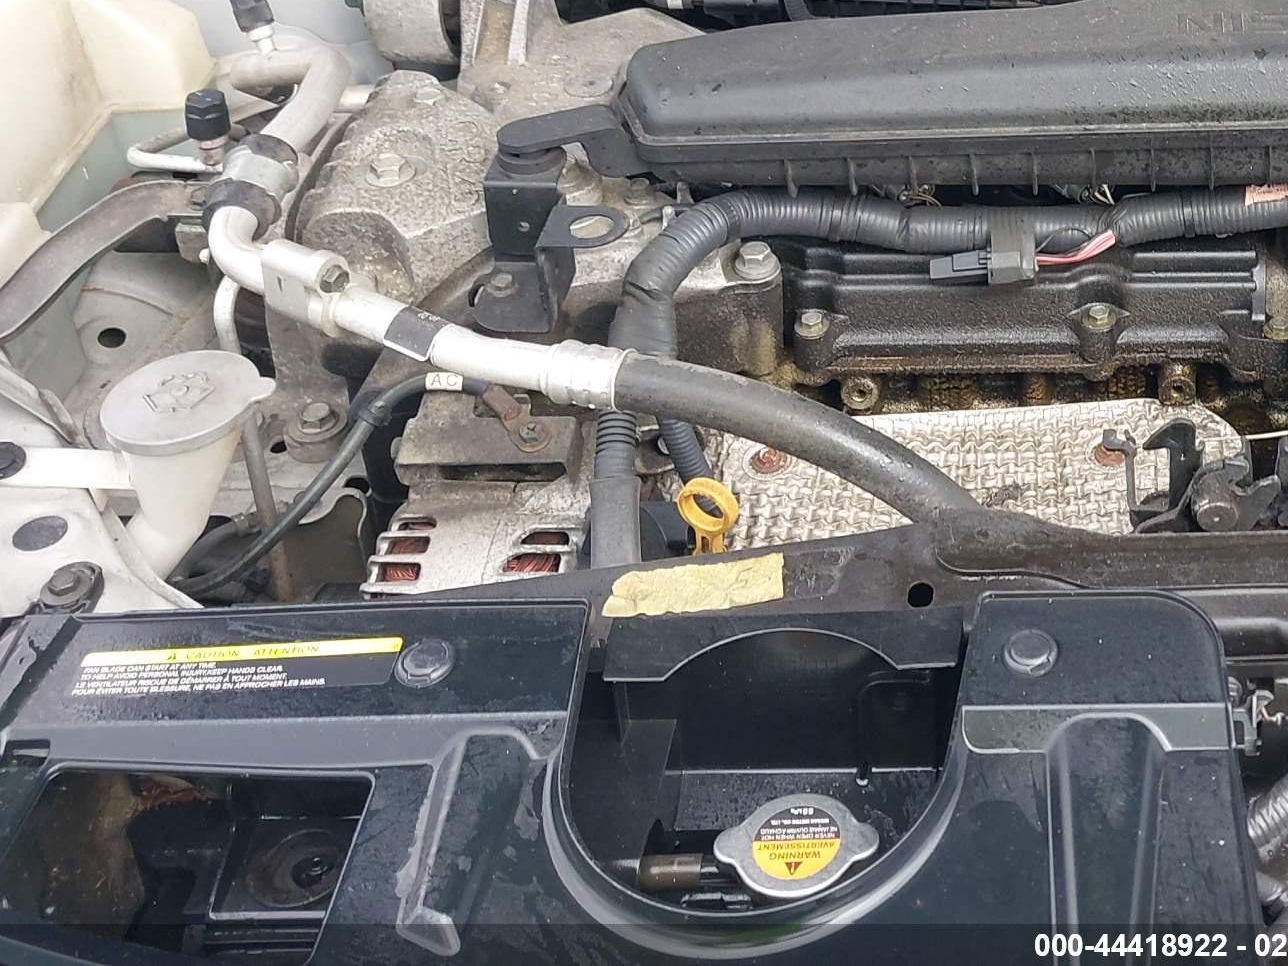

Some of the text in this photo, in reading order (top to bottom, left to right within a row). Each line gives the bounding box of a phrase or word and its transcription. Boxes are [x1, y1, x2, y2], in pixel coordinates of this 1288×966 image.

[113, 672, 138, 680] AVOID
[138, 670, 180, 679] PERSONAL
[228, 666, 256, 675] HANDS
[87, 680, 137, 688] VENTILATEUR
[137, 678, 166, 687] RISQUE
[231, 674, 252, 682] TOUT
[123, 686, 149, 694] TOUTE
[205, 683, 222, 691] PAS
[221, 682, 235, 690] EN
[234, 680, 284, 690] APPROCHER
[284, 679, 300, 687] LES
[758, 841, 835, 851] AVERTISSEMENT
[768, 851, 821, 860] WARNING
